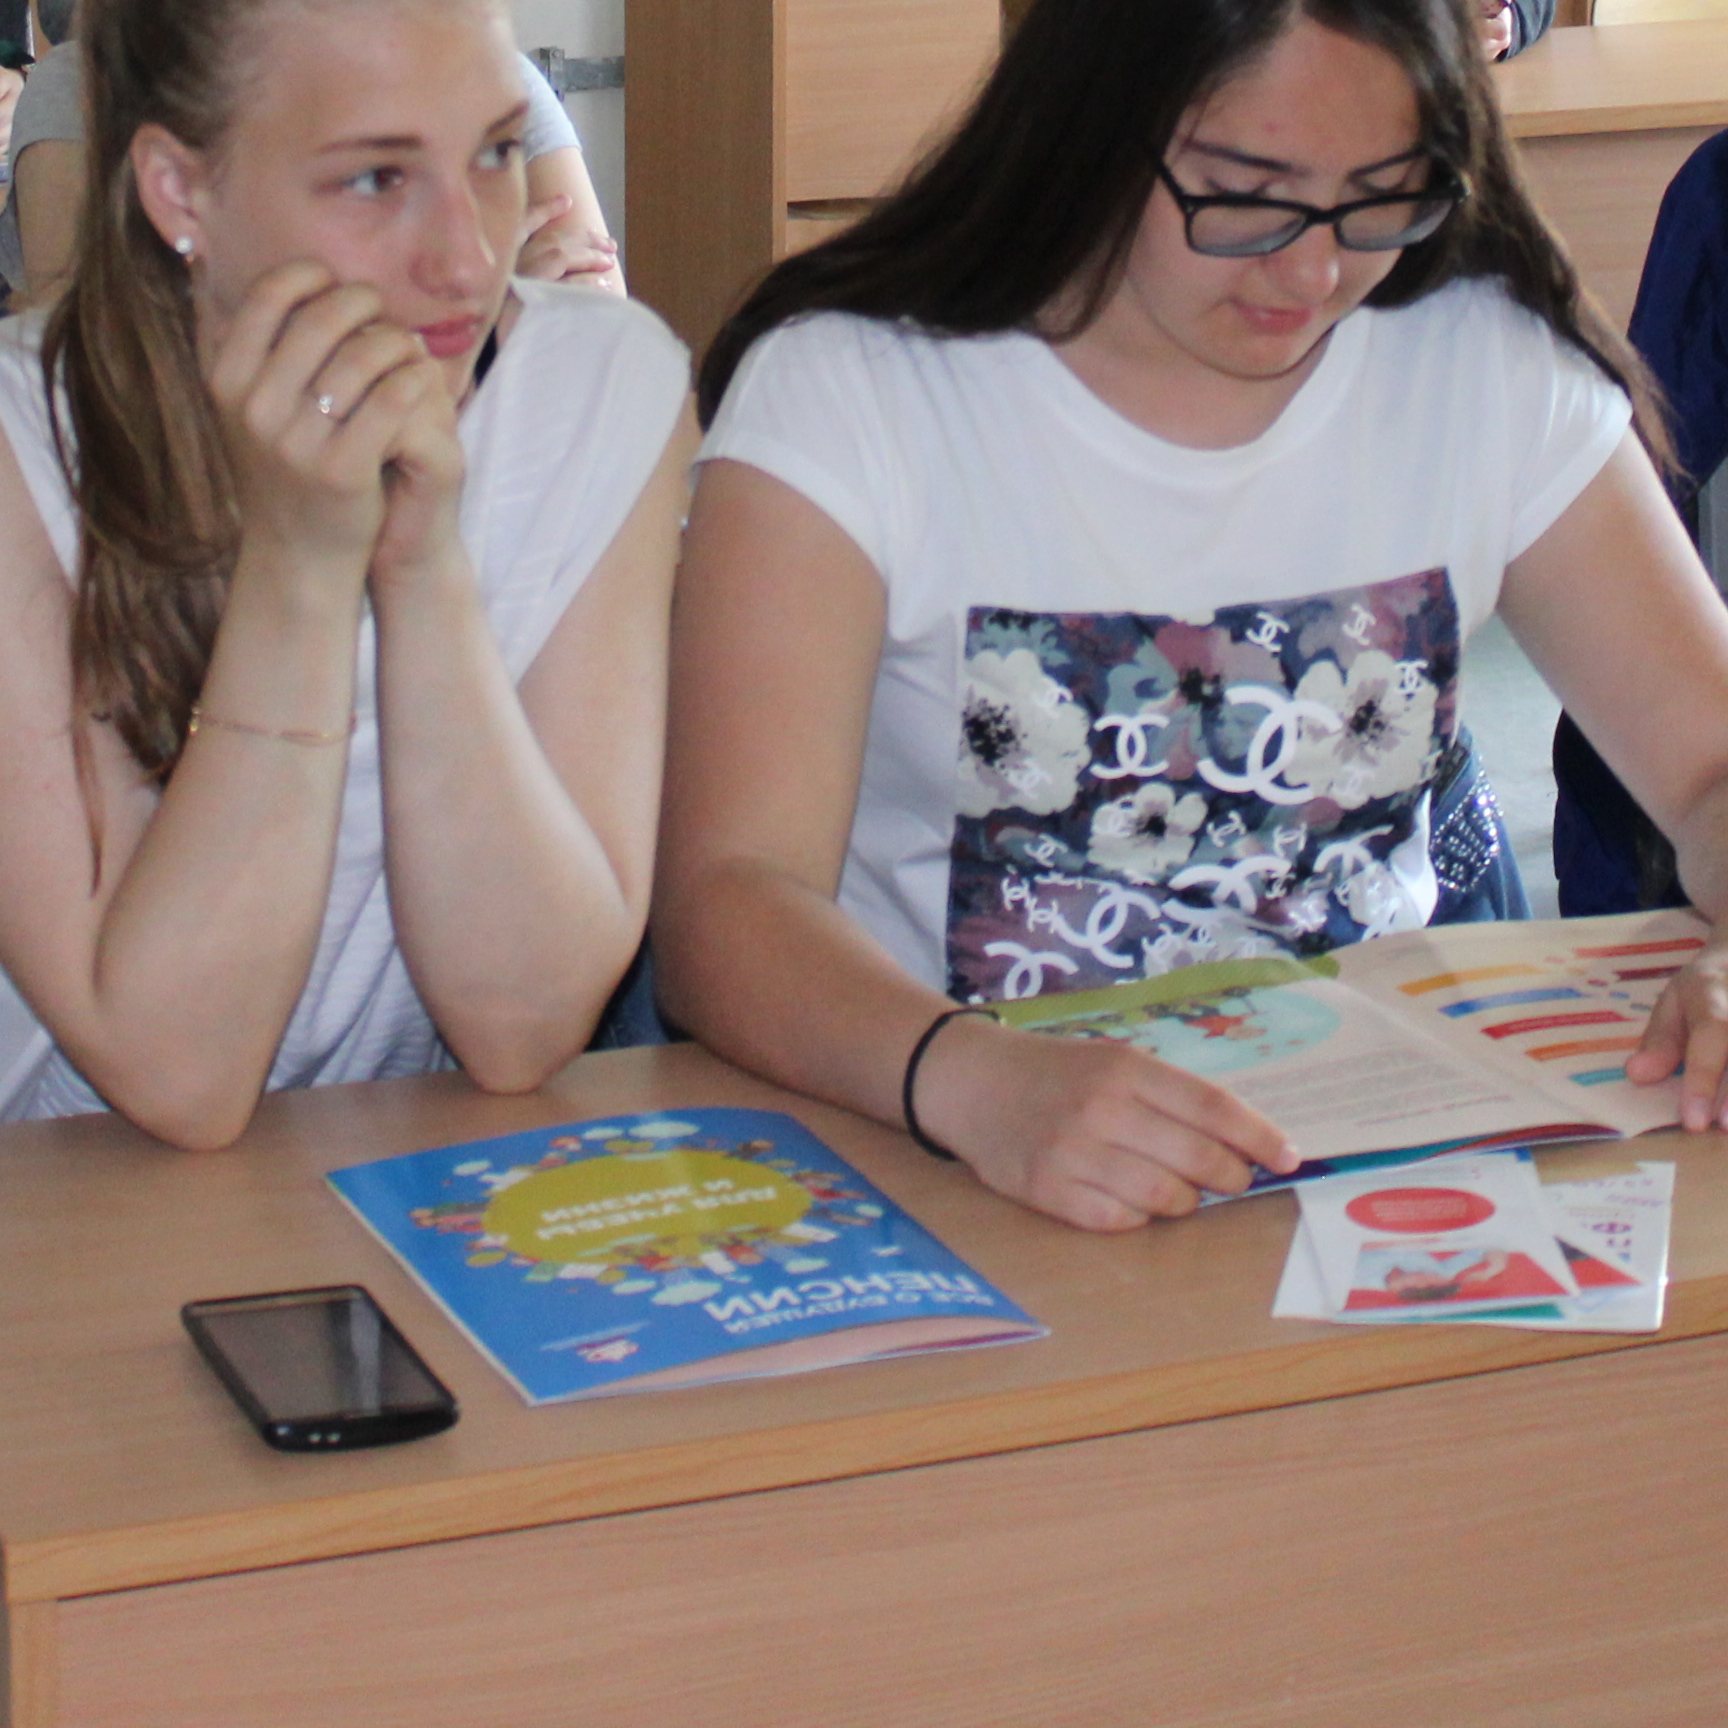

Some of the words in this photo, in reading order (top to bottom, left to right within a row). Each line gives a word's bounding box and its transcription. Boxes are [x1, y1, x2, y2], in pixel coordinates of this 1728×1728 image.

[703, 1178, 733, 1192] И
[702, 1271, 978, 1321] ПЕНСИИ
[893, 1291, 922, 1304] О
